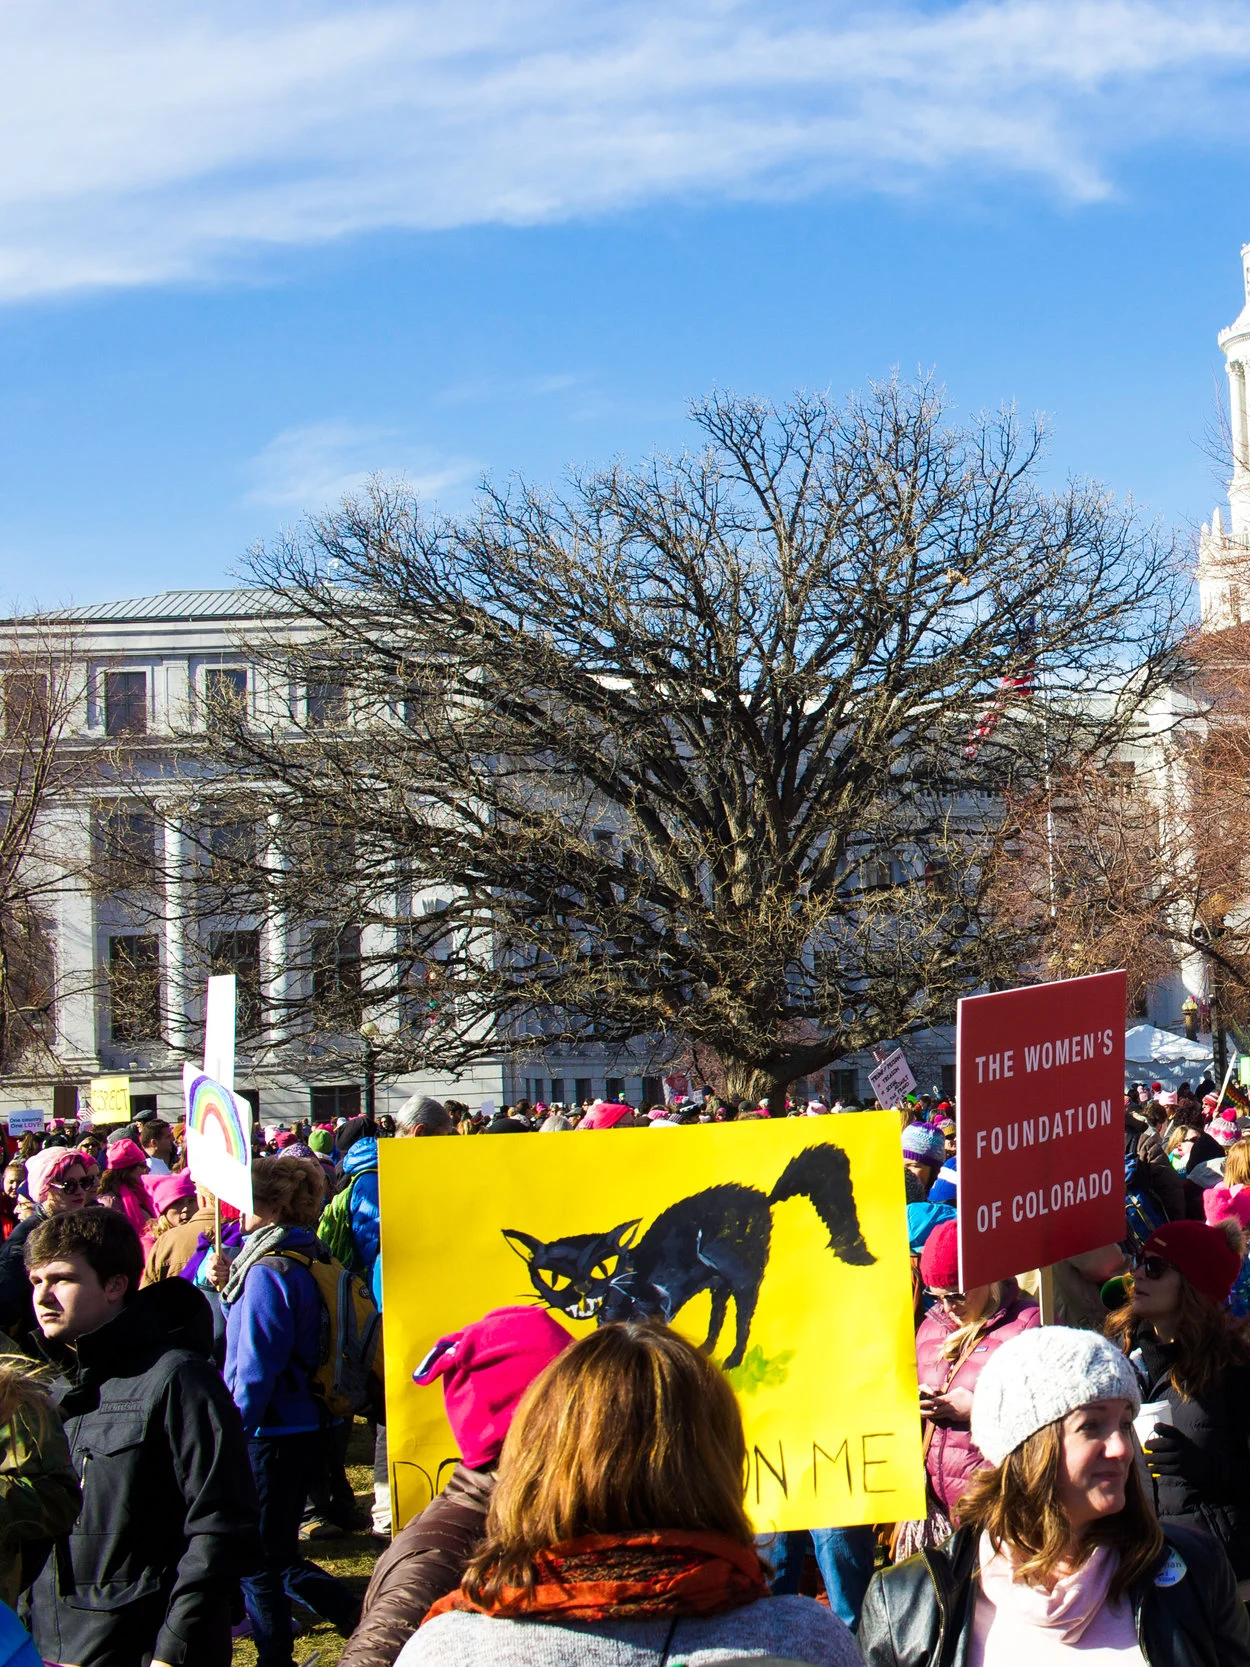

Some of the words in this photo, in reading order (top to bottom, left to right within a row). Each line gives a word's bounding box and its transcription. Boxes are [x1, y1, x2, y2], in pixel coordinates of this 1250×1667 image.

[975, 1050, 1014, 1084] THE
[1024, 1029, 1113, 1073] WOMEN'S
[976, 1099, 1112, 1159] FOUNDATION
[977, 1201, 1002, 1233] OF
[1012, 1169, 1112, 1223] COLORADO
[743, 1440, 788, 1504] N
[813, 1432, 898, 1499] ME
